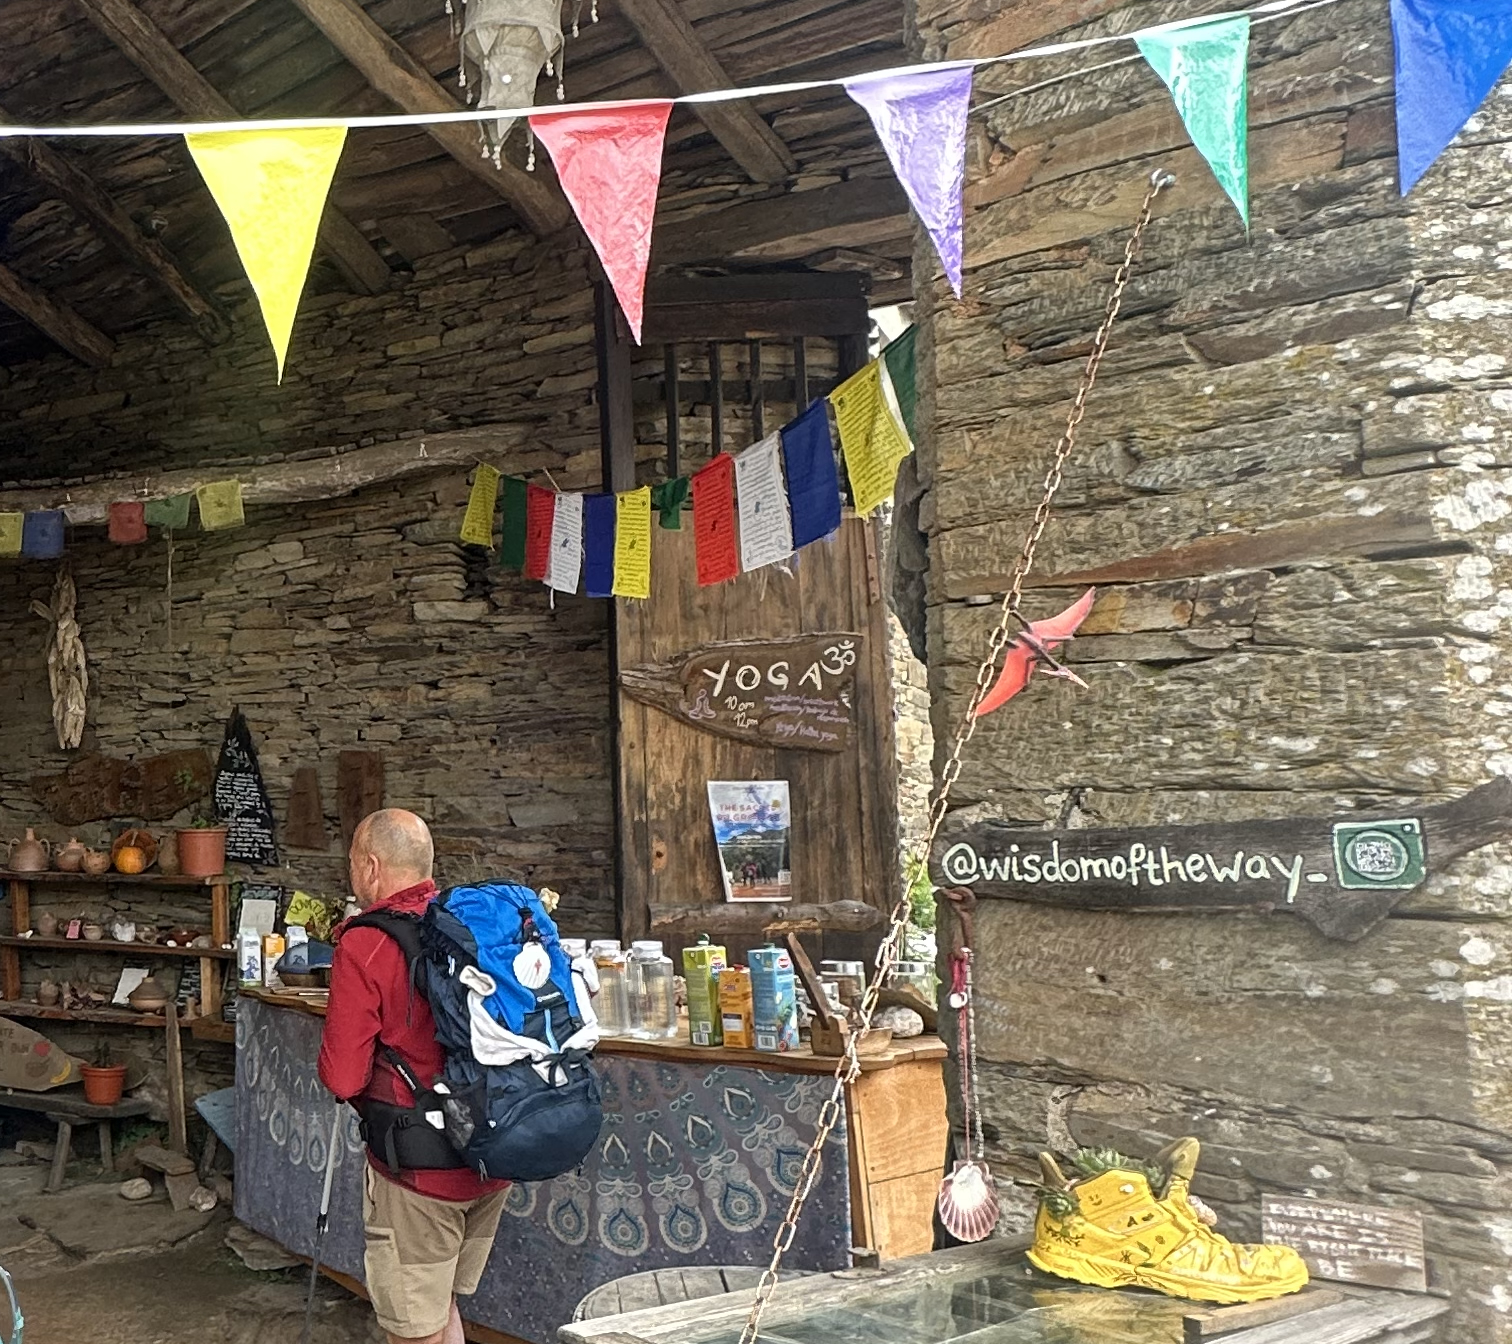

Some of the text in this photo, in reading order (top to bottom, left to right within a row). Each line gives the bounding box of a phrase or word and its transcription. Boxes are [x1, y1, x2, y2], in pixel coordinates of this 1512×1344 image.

[701, 659, 823, 698] YOGA
[719, 803, 737, 812] THE
[941, 840, 1329, 904] @wisdomoftheway_
[1301, 1223, 1352, 1241] ARE
[1317, 1258, 1360, 1280] BE
